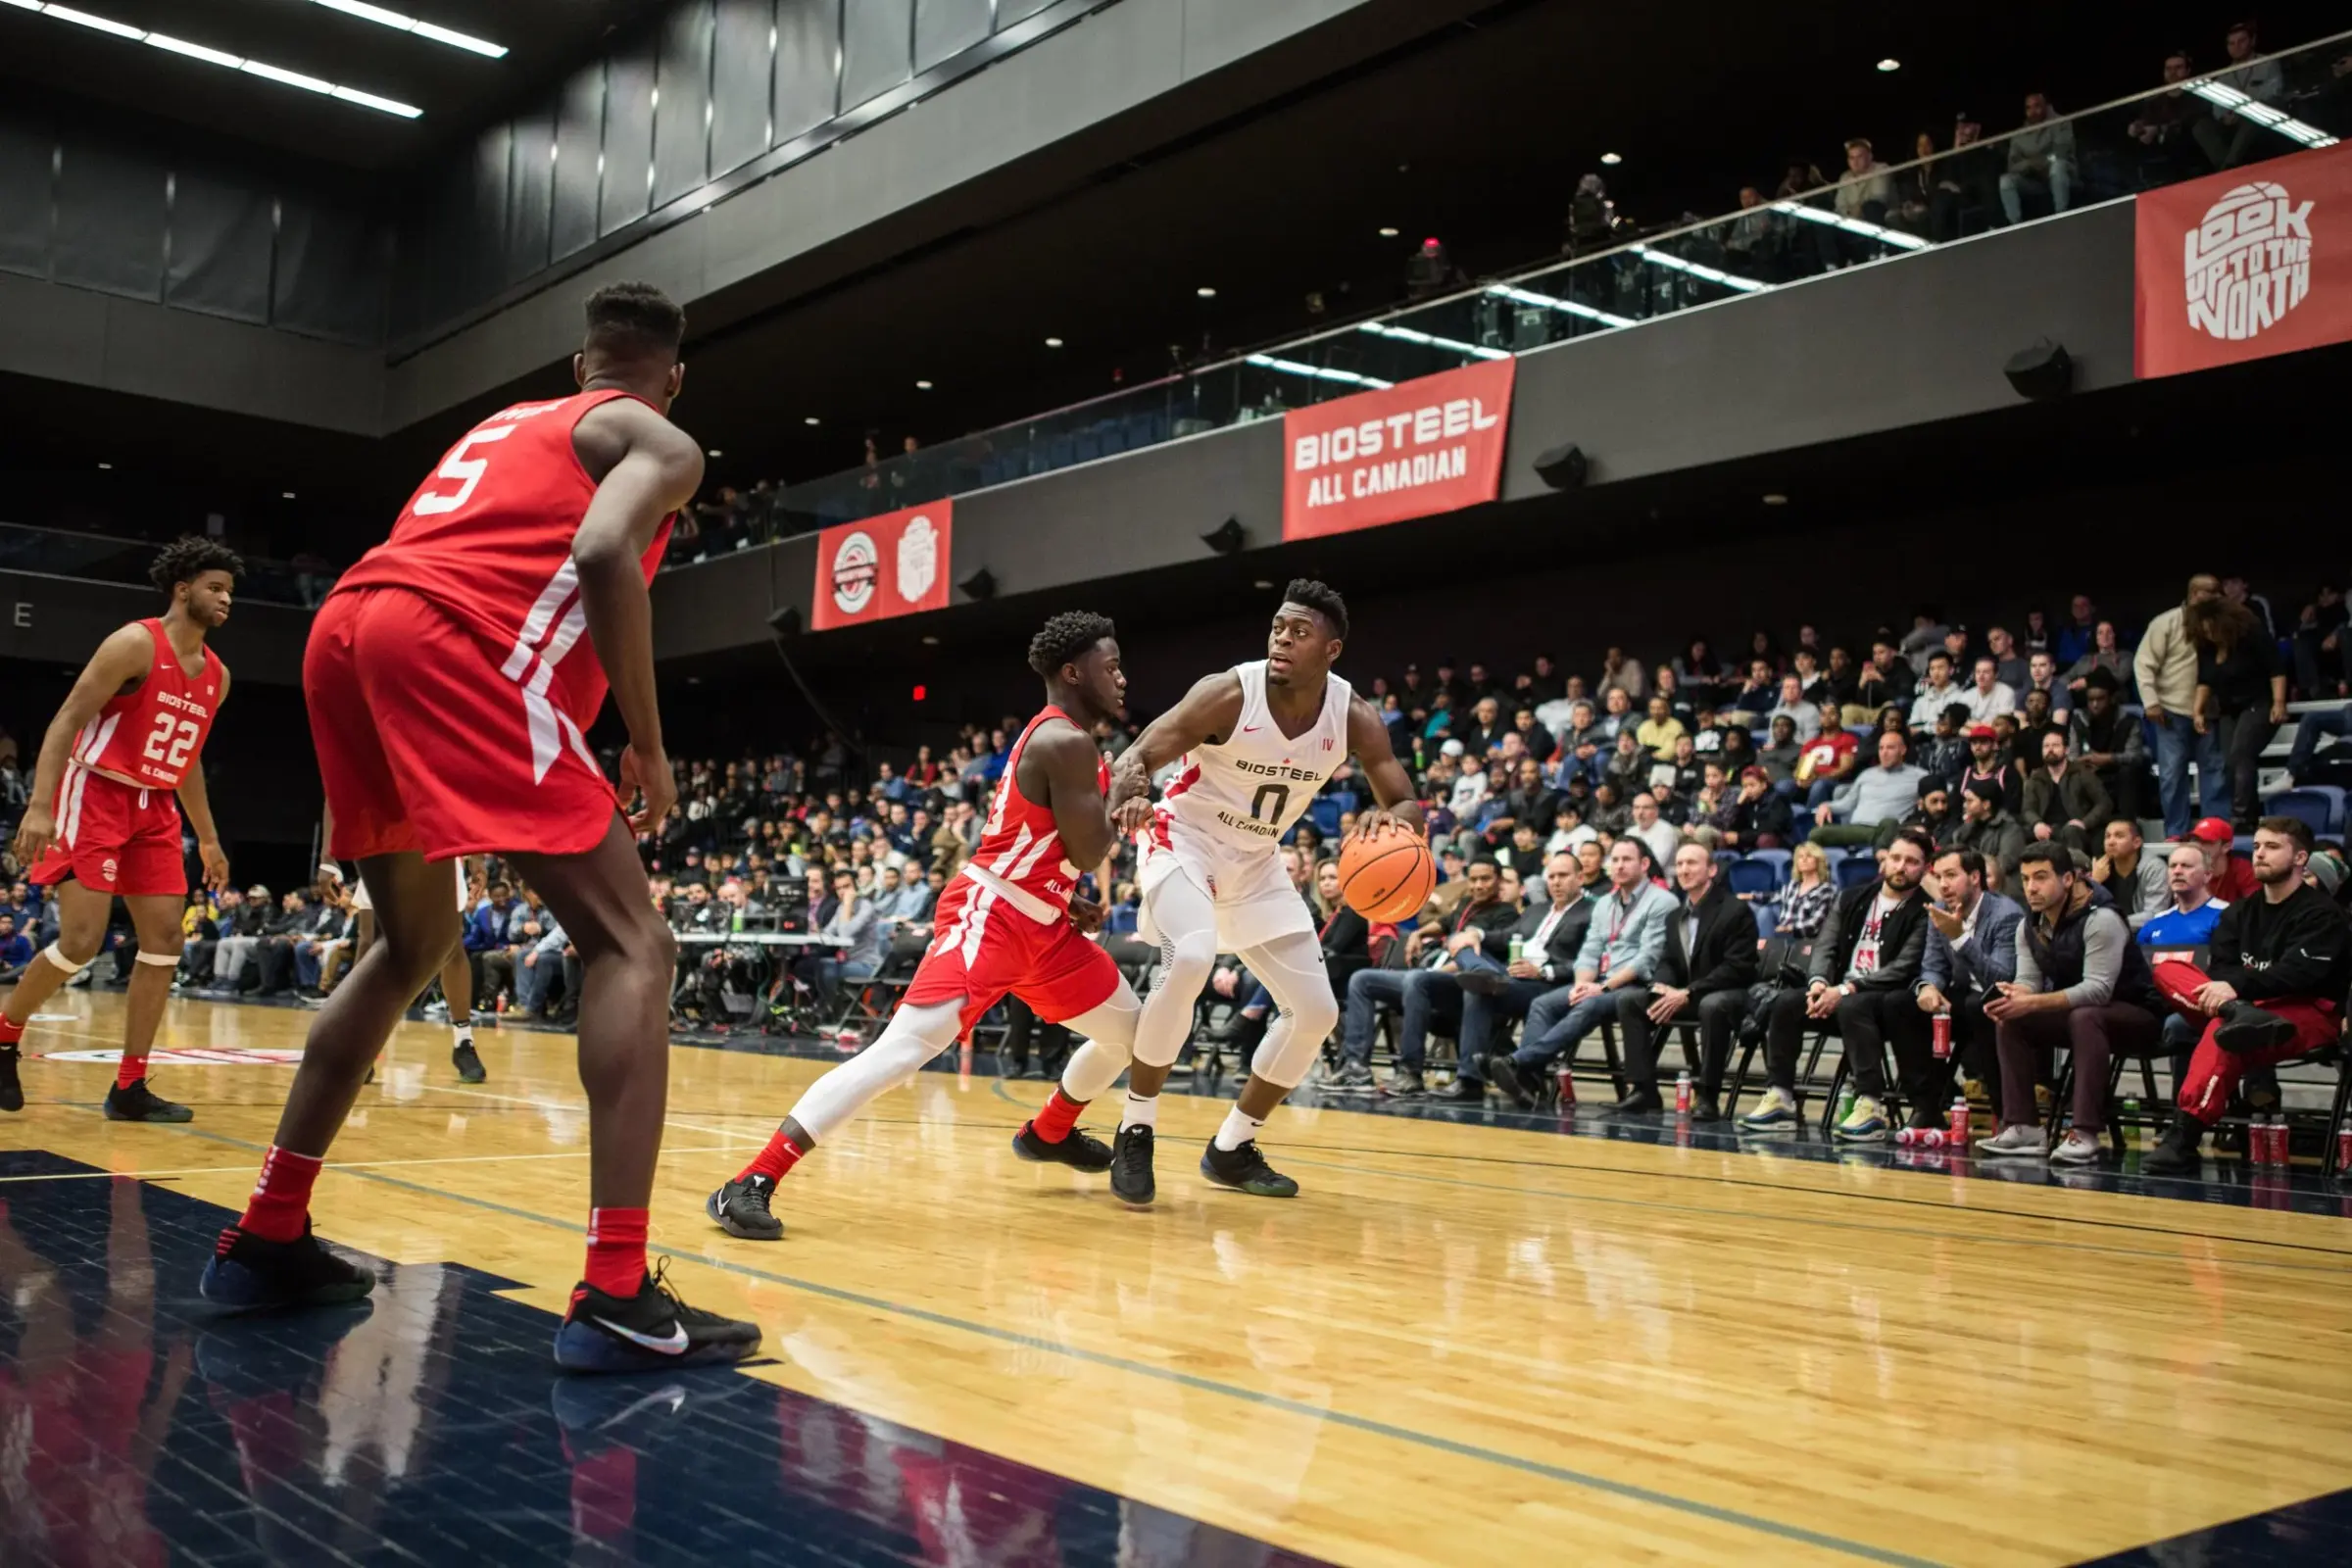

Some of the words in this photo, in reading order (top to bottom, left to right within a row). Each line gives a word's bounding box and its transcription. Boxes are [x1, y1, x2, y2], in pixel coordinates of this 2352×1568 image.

[2184, 201, 2315, 279] LOOK
[2186, 258, 2228, 310] UP
[2228, 244, 2266, 282] TO
[2266, 237, 2313, 269] THE
[2186, 263, 2310, 340] NORTH
[1295, 398, 1498, 471] BIOSTEEL
[413, 424, 517, 515] 5
[1307, 473, 1346, 508] ALL
[1352, 446, 1466, 498] CANADIAN
[14, 602, 33, 627] E
[157, 690, 208, 718] BIOSTEEL
[143, 711, 200, 768] 22
[1322, 738, 1334, 752] IV
[1236, 759, 1323, 782] BIOSTEEL
[1217, 810, 1234, 826] ALL
[1250, 783, 1290, 825] 0
